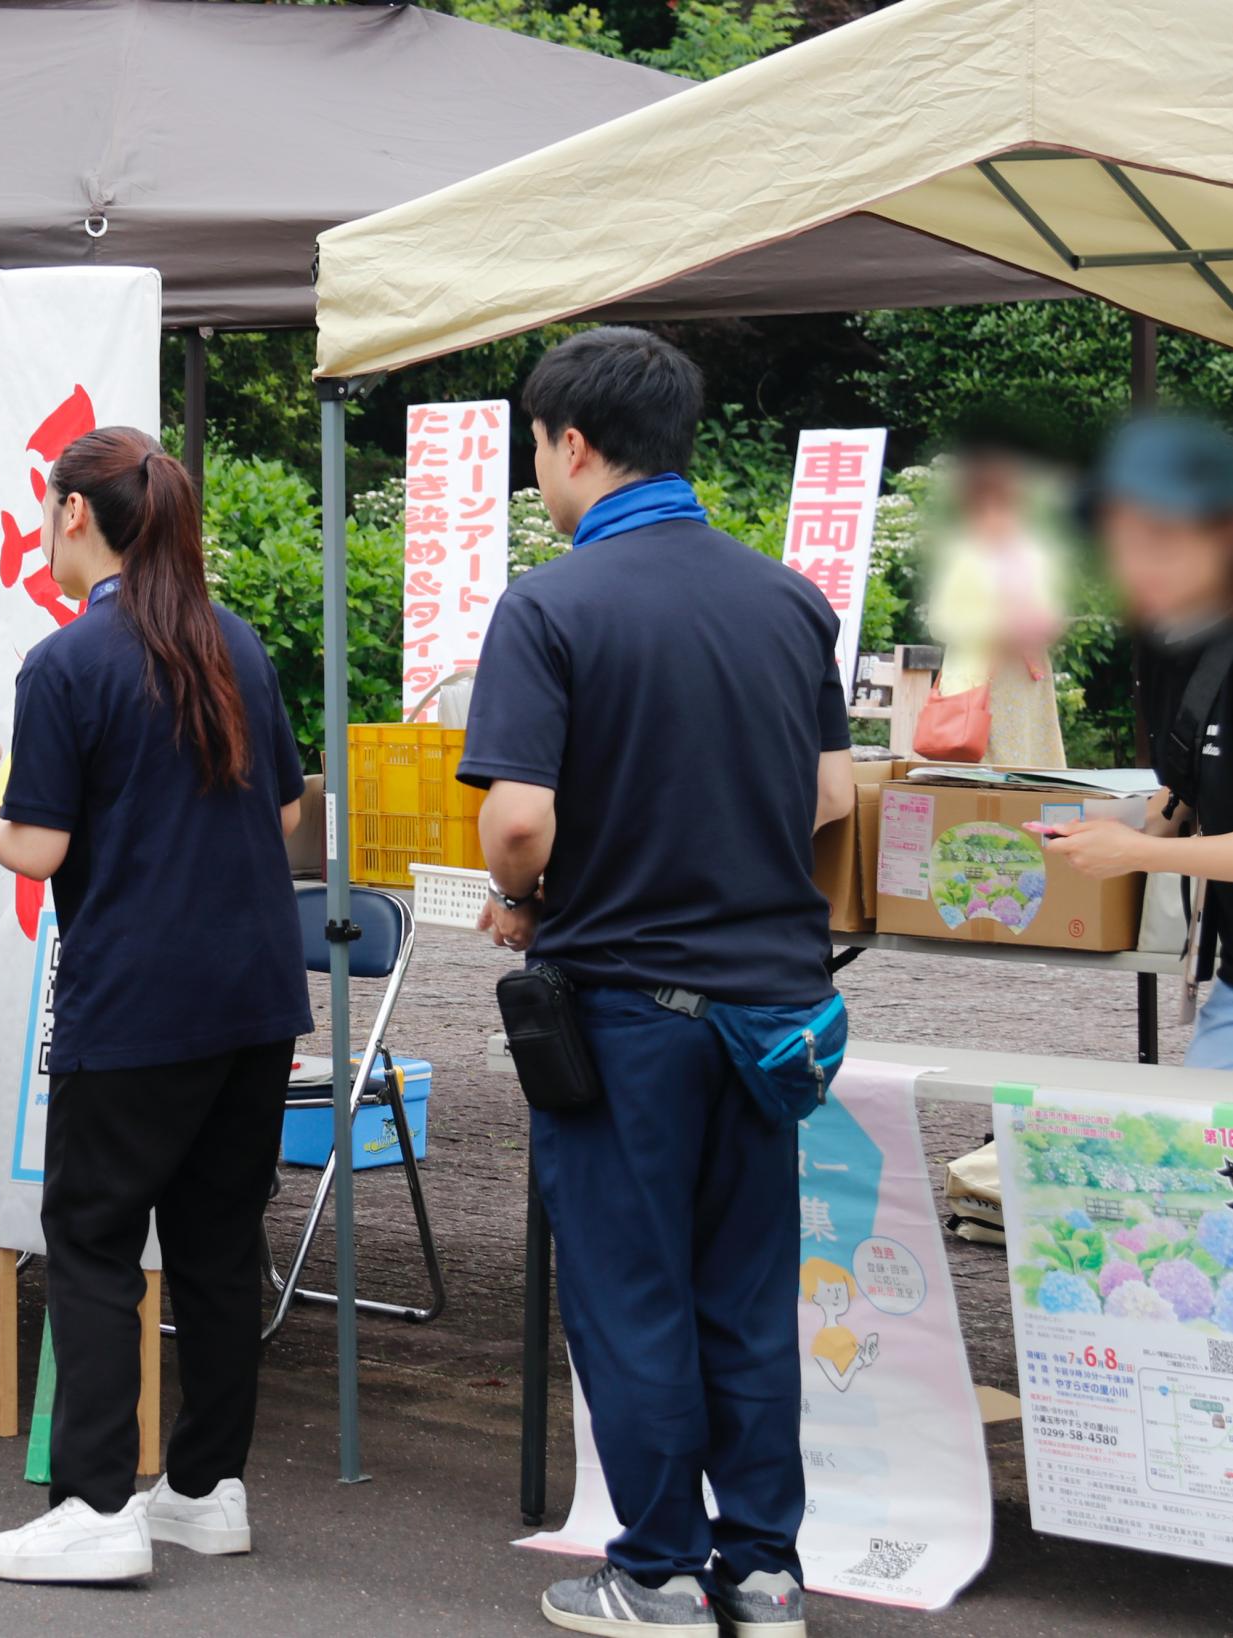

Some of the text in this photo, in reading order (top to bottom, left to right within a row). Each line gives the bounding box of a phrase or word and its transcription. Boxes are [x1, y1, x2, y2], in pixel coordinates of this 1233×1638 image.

[453, 405, 501, 675] バルーンアート・
[785, 441, 869, 612] 車両進
[1056, 1379, 1128, 1398] やすらぎの里小川
[1040, 1428, 1117, 1447] 0299-58-4580
